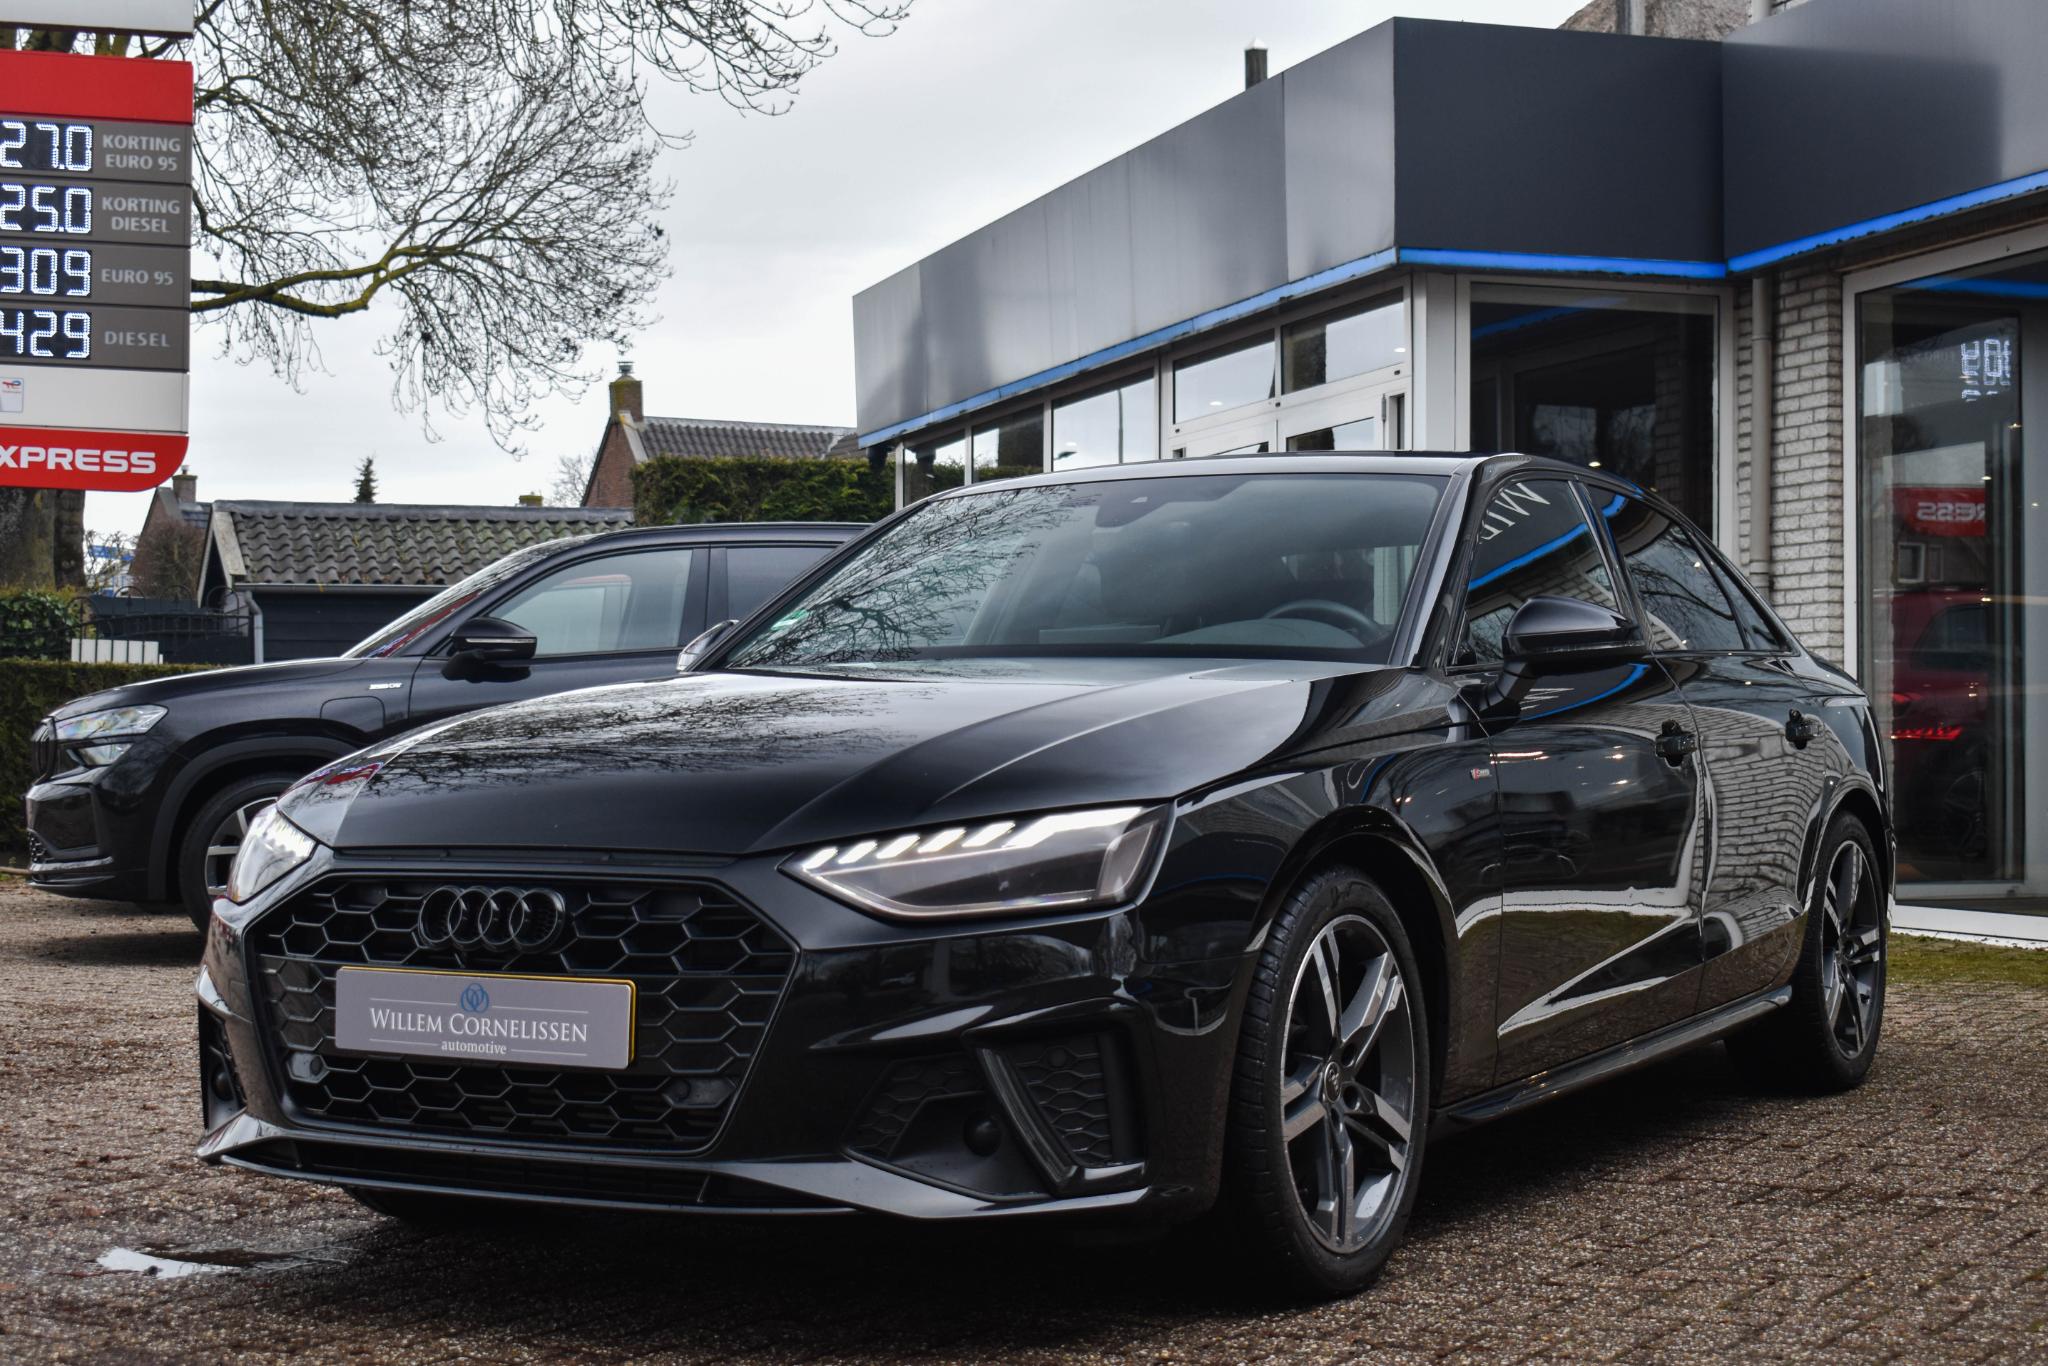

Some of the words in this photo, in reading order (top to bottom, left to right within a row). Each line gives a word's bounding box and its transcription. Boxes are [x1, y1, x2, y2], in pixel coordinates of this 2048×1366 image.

[102, 135, 181, 152] KORTING
[105, 154, 153, 170] EURO
[158, 157, 177, 171] 95
[102, 196, 181, 214] KORTING
[111, 216, 170, 233] DIESEL
[101, 268, 149, 285] EURO
[154, 272, 174, 286] 95
[104, 331, 170, 348] DIESEL
[441, 1040, 507, 1055] automotive
